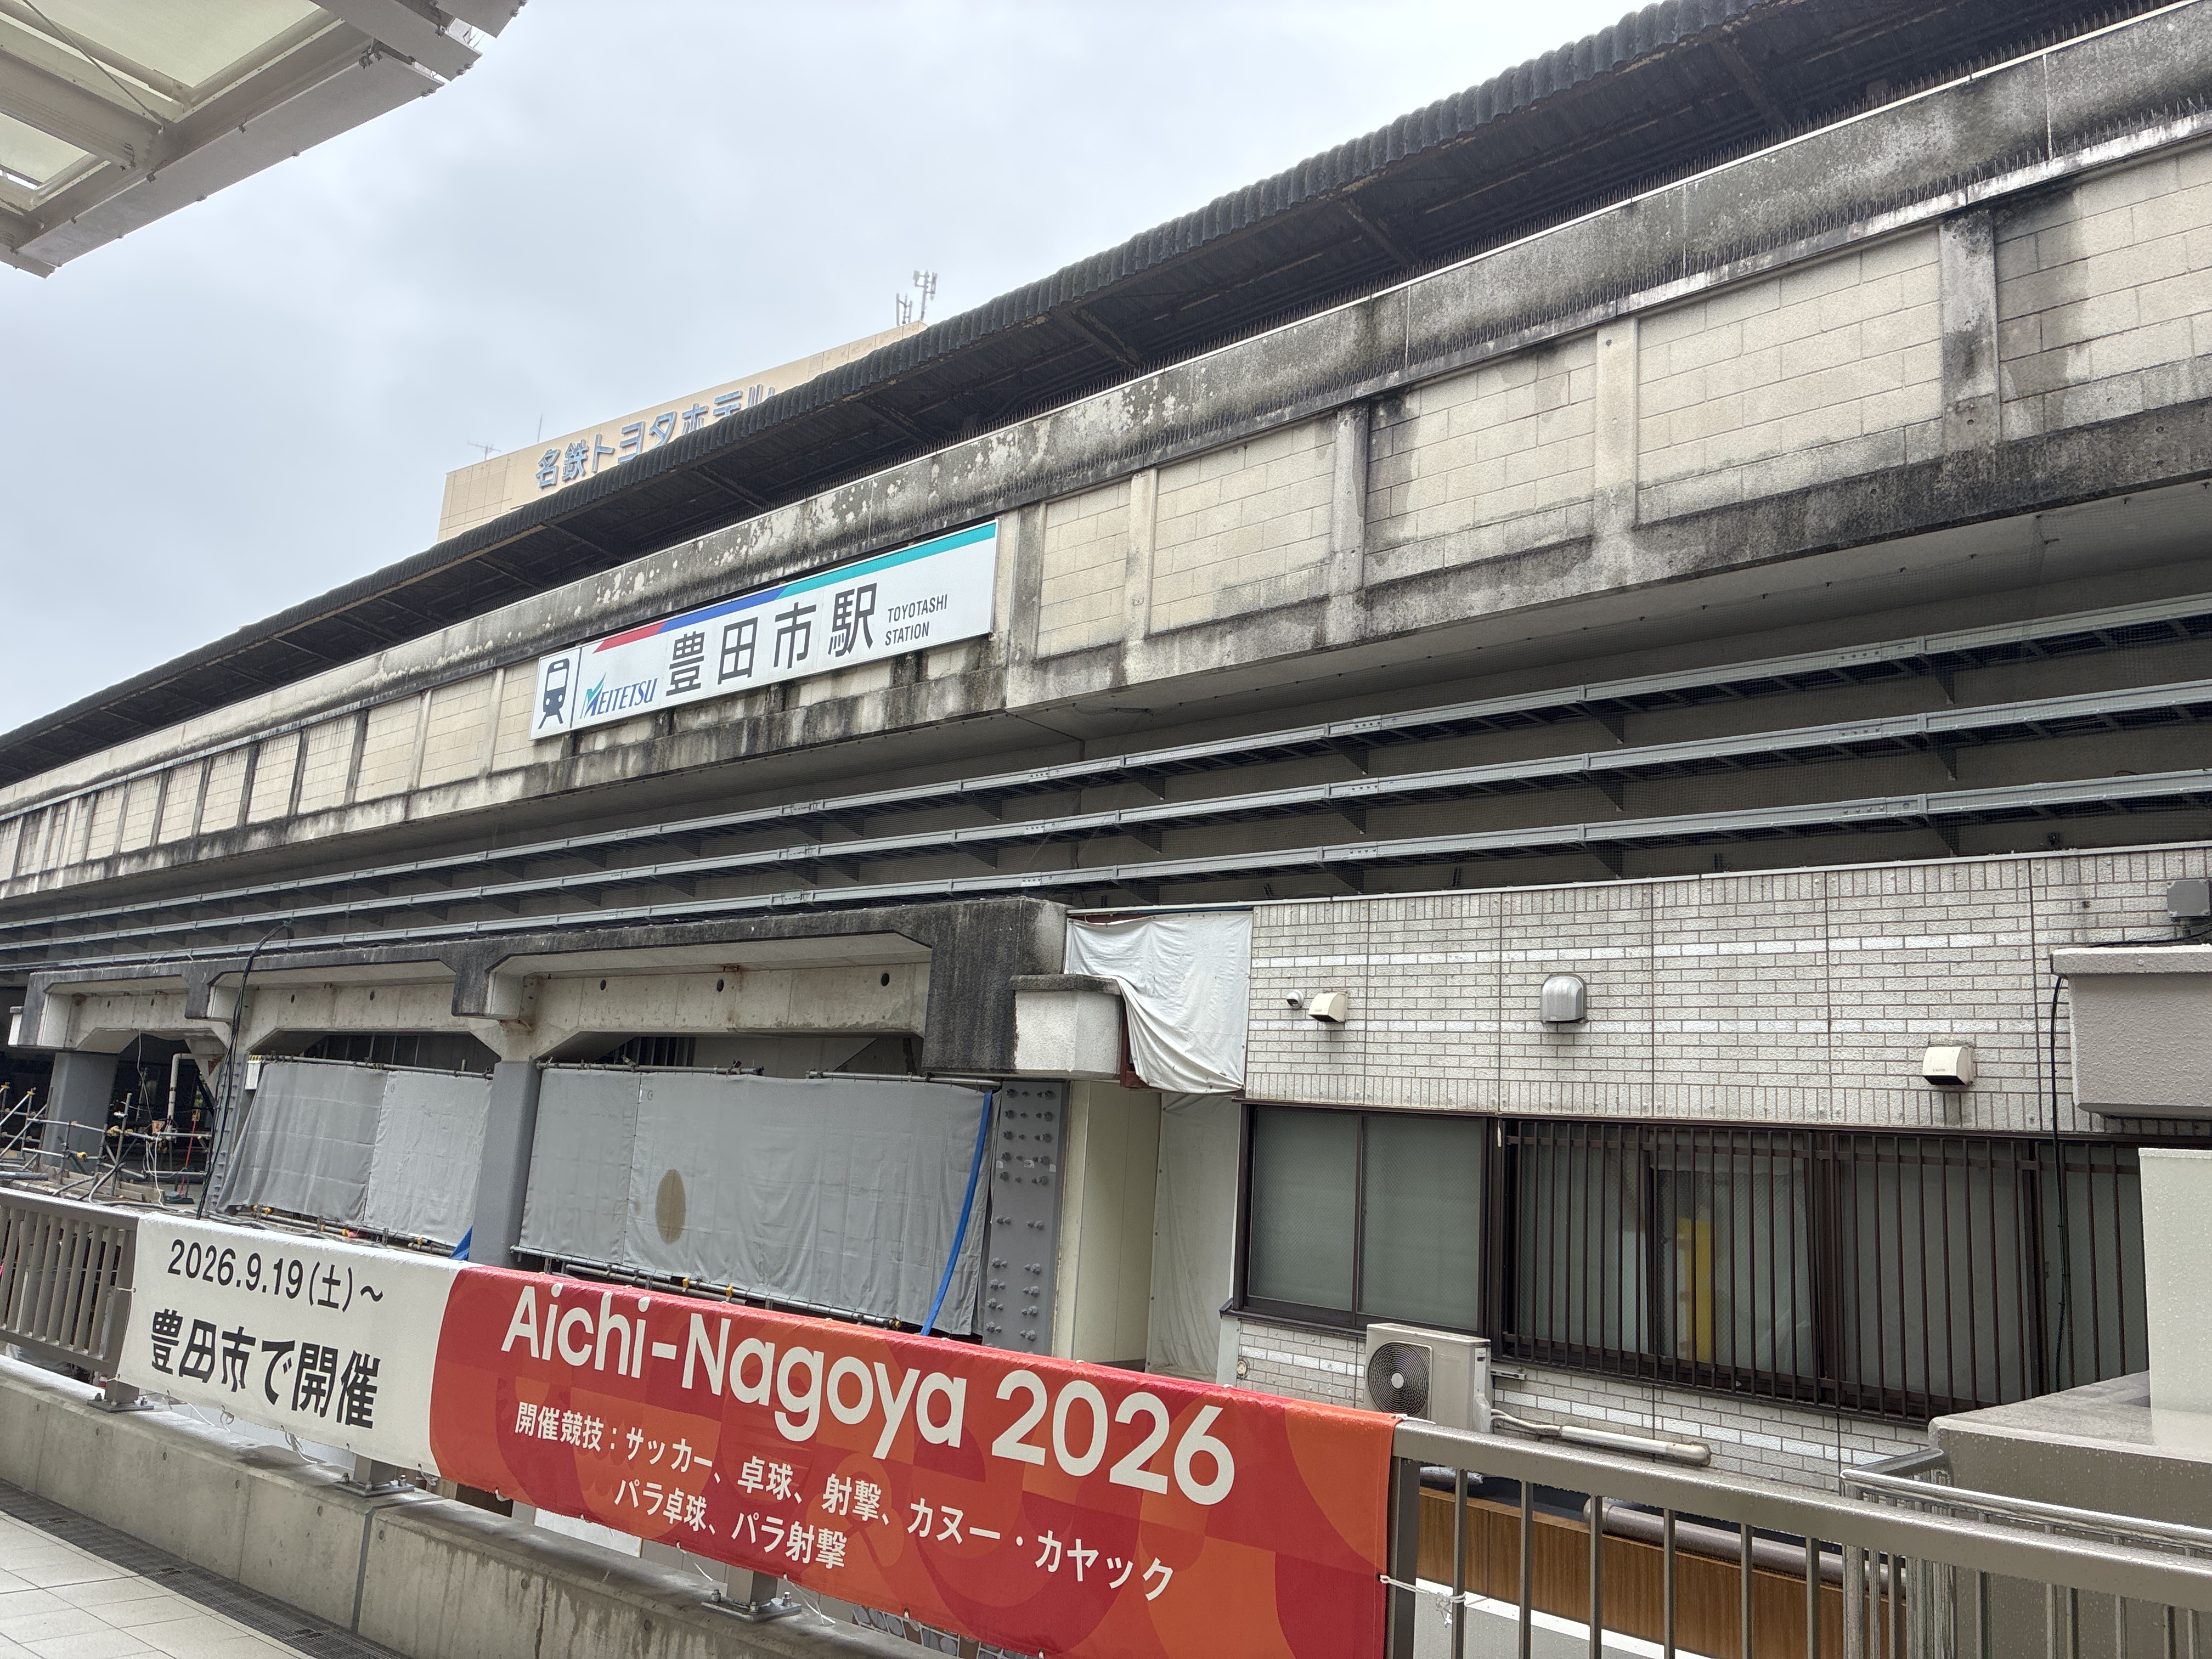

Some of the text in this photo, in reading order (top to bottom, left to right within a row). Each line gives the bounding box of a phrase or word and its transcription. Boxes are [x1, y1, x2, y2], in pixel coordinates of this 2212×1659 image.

[666, 583, 877, 696] 豊田市駅
[885, 621, 929, 646] STATION
[888, 594, 947, 623] TOYOTASHI
[580, 672, 658, 719] MEITETSU
[151, 1308, 381, 1429] 豊田市で開催
[500, 1283, 1235, 1505] Aichi-Nagoya 2026
